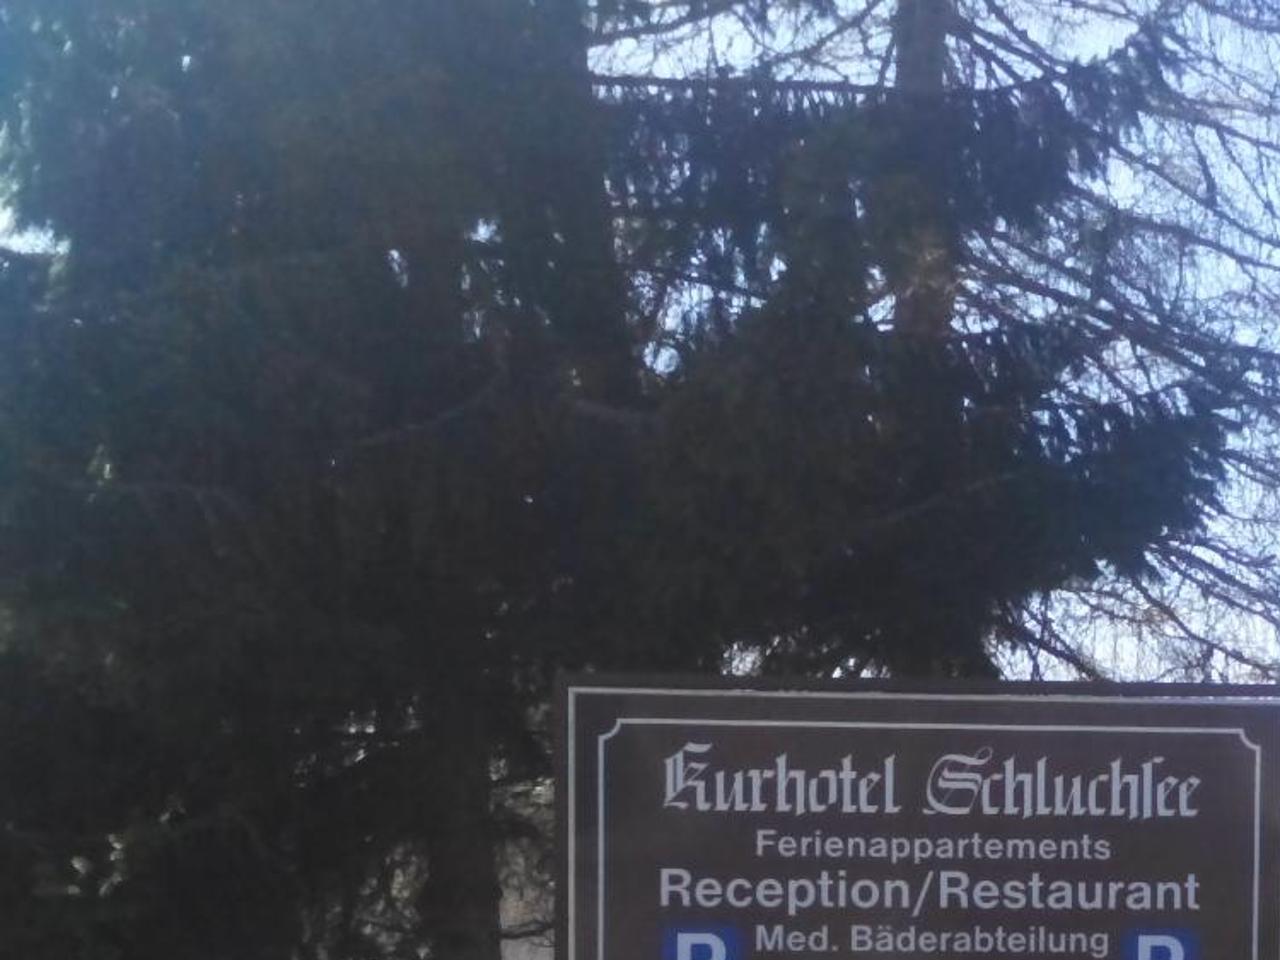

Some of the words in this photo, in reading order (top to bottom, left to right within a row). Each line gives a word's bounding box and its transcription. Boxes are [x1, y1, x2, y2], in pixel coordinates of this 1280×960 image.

[663, 742, 901, 815] Kurhotel
[755, 830, 1111, 864] Ferienappartements
[658, 868, 1200, 916] Reception/Restaurant
[755, 925, 839, 952] Med.
[851, 925, 1109, 958] Bäderabteilung
